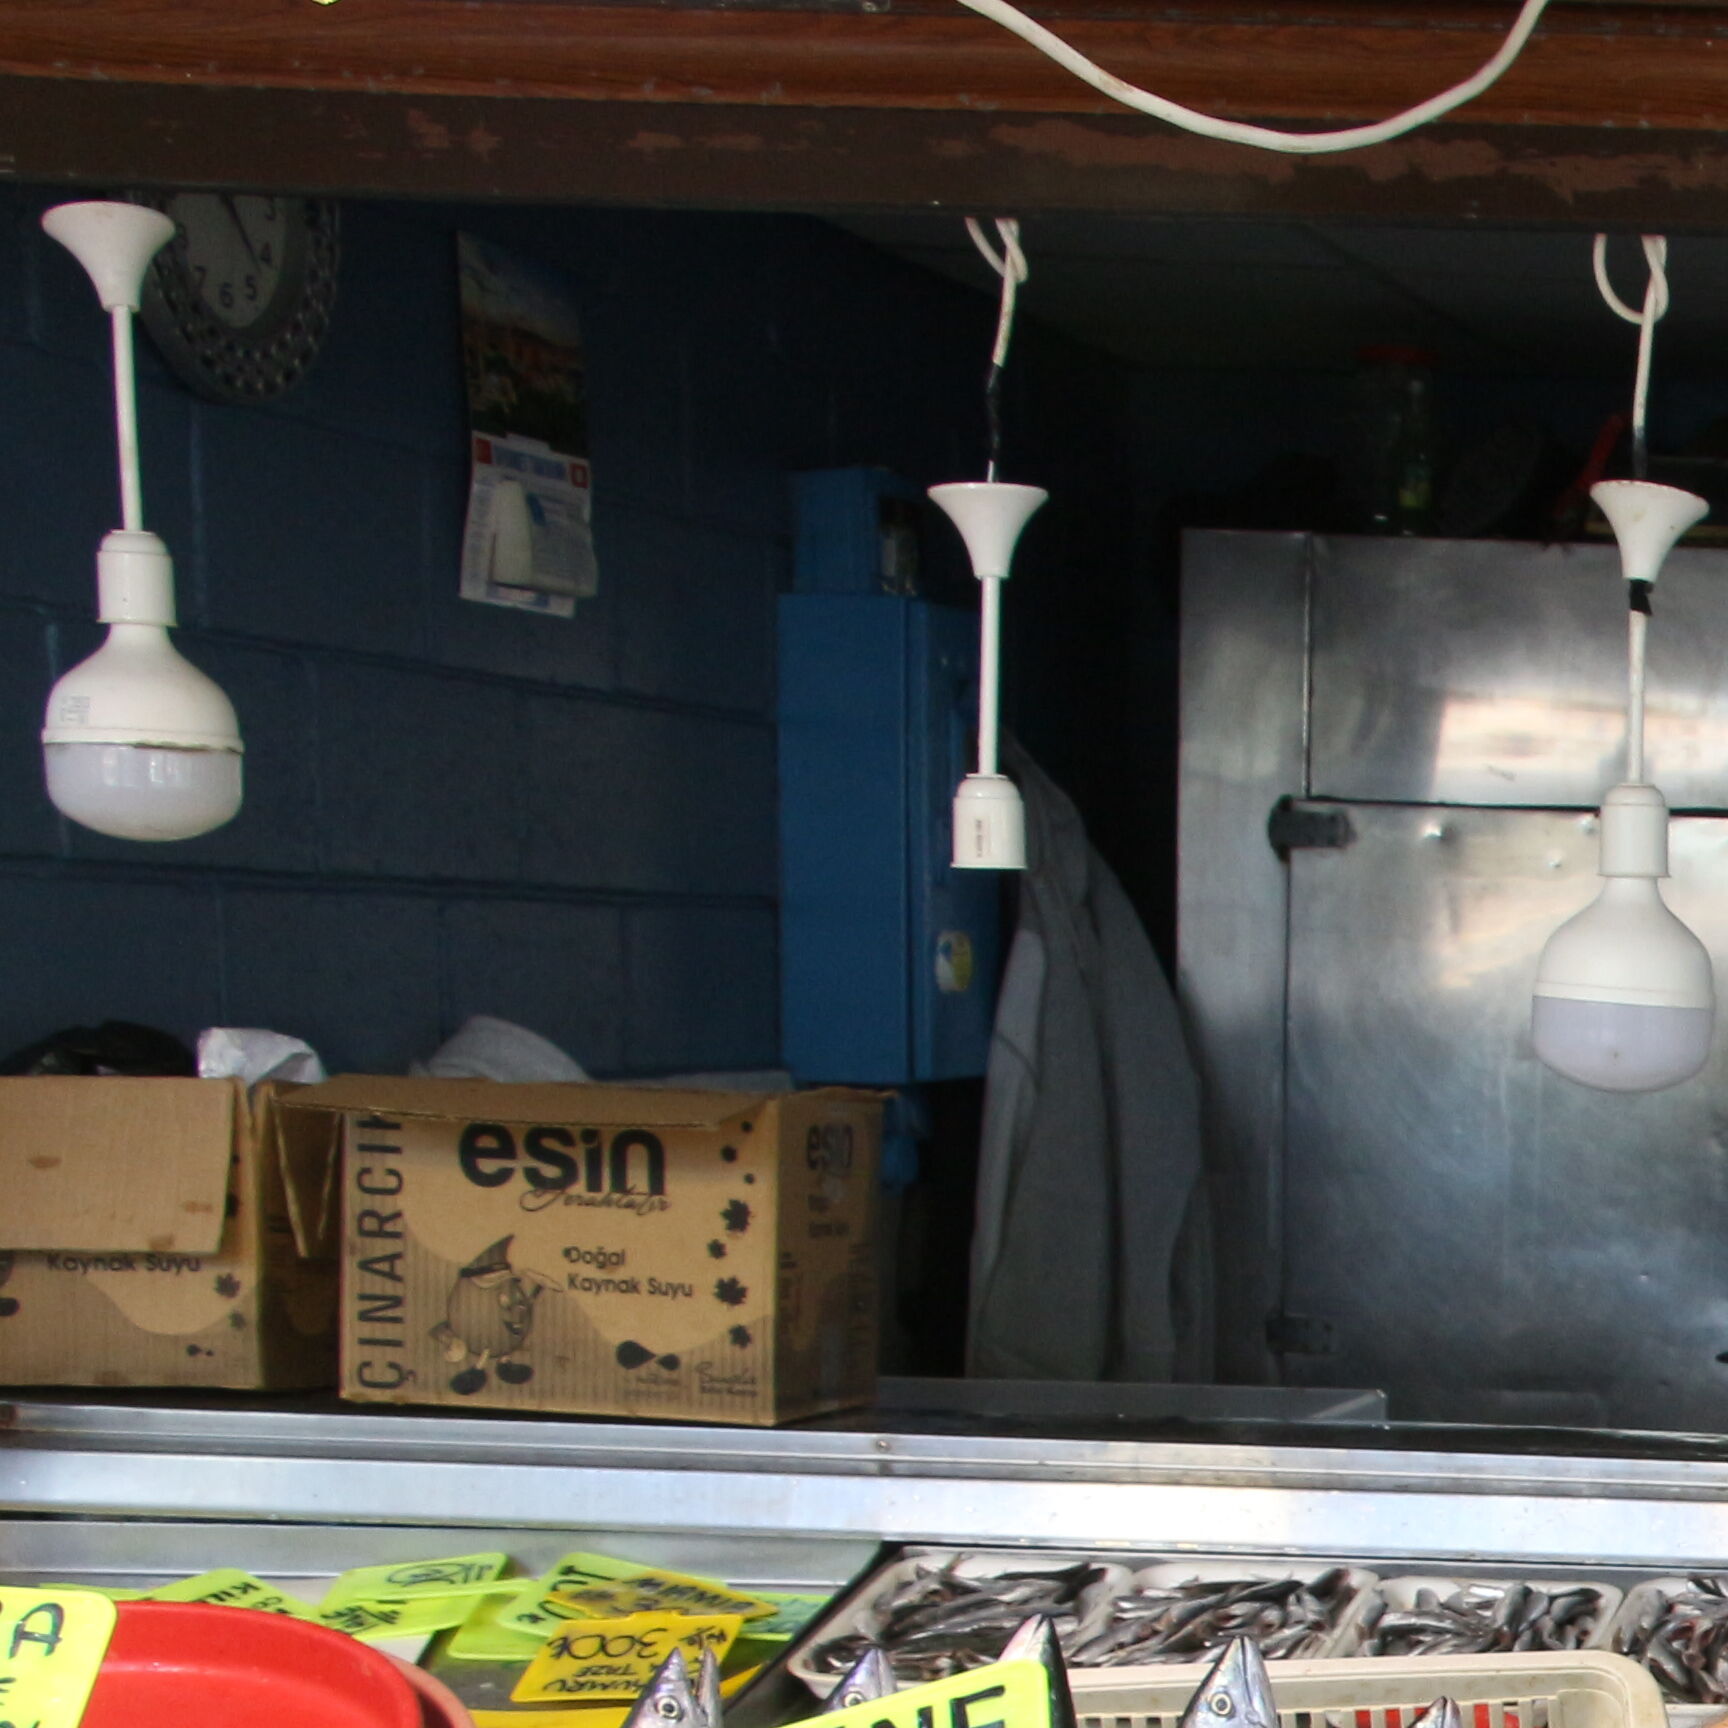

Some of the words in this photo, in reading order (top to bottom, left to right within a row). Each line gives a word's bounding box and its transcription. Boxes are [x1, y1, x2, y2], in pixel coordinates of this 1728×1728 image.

[220, 281, 234, 309] 6
[245, 274, 257, 301] 5
[457, 1122, 666, 1196] esin
[566, 1246, 625, 1270] Doğal
[567, 1272, 640, 1295] Kaynak
[647, 1276, 693, 1300] Suyu
